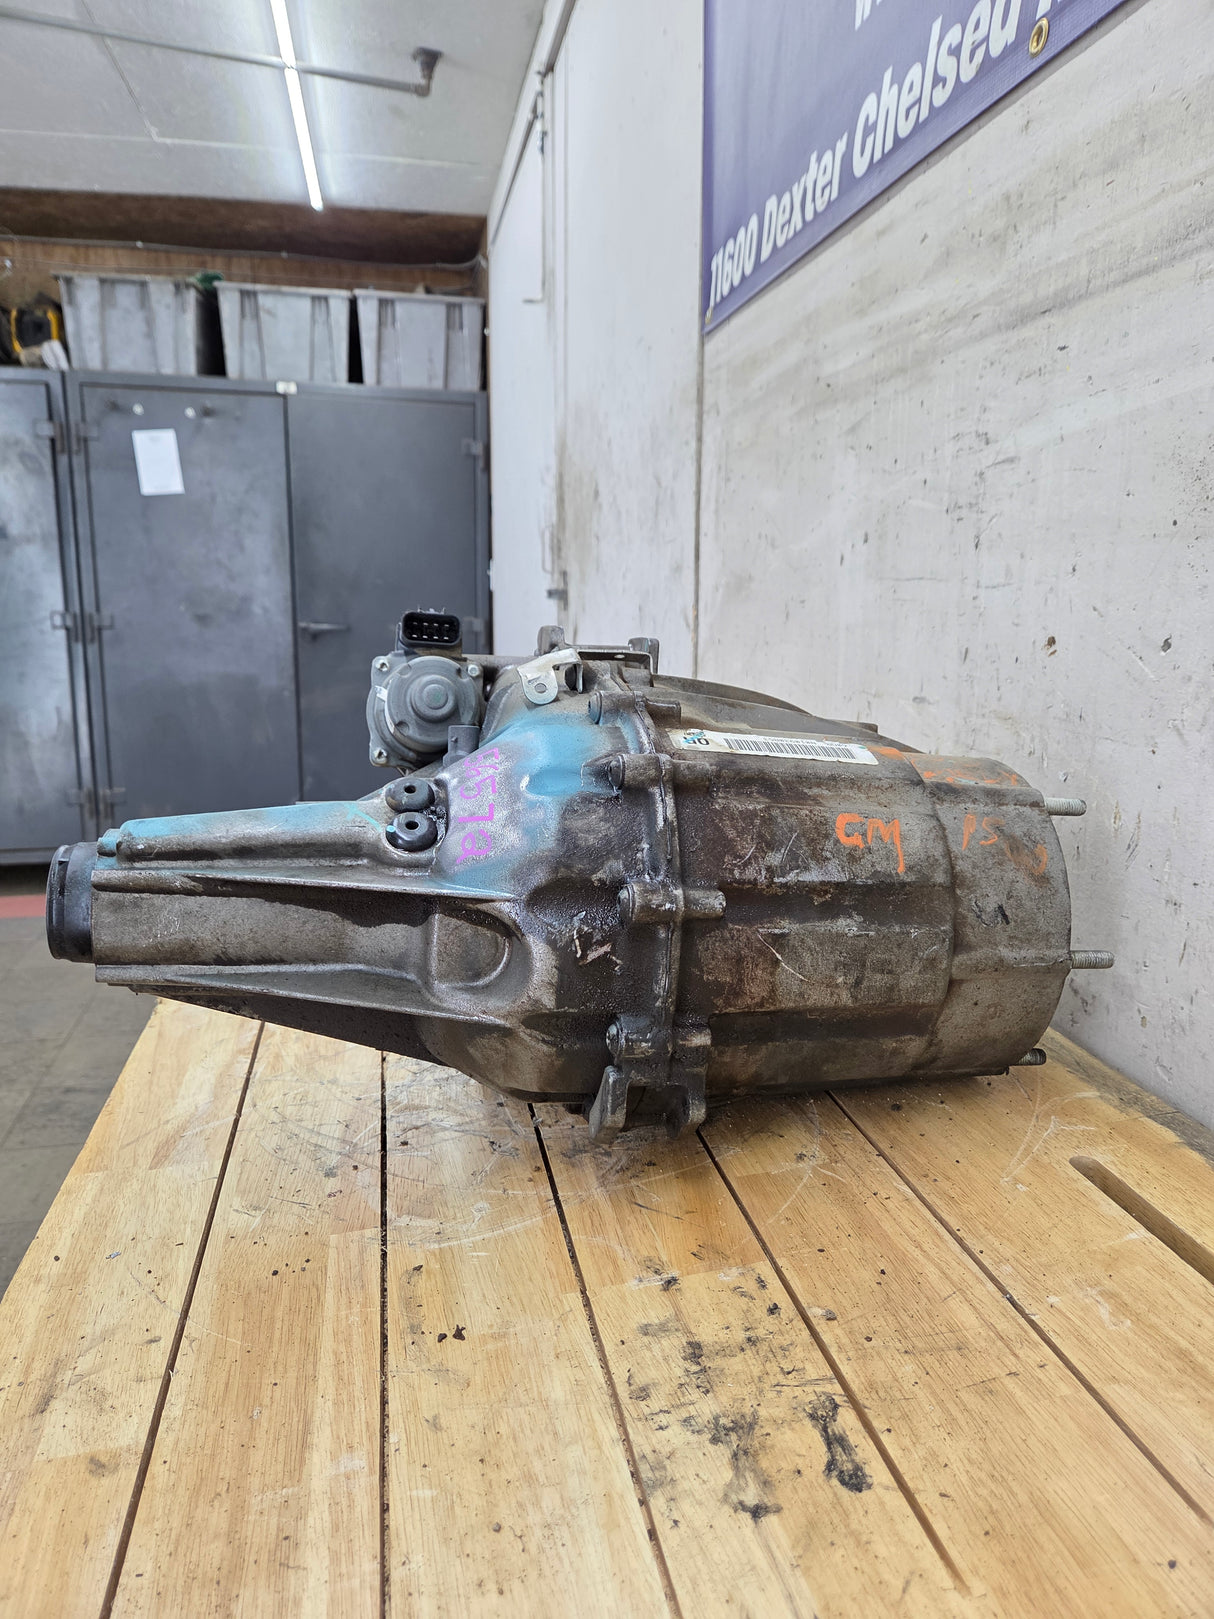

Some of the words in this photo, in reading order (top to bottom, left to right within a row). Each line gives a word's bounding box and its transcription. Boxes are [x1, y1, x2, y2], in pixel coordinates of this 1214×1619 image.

[709, 213, 757, 309] 11600
[760, 132, 848, 264] Dexter
[835, 812, 905, 873] GM
